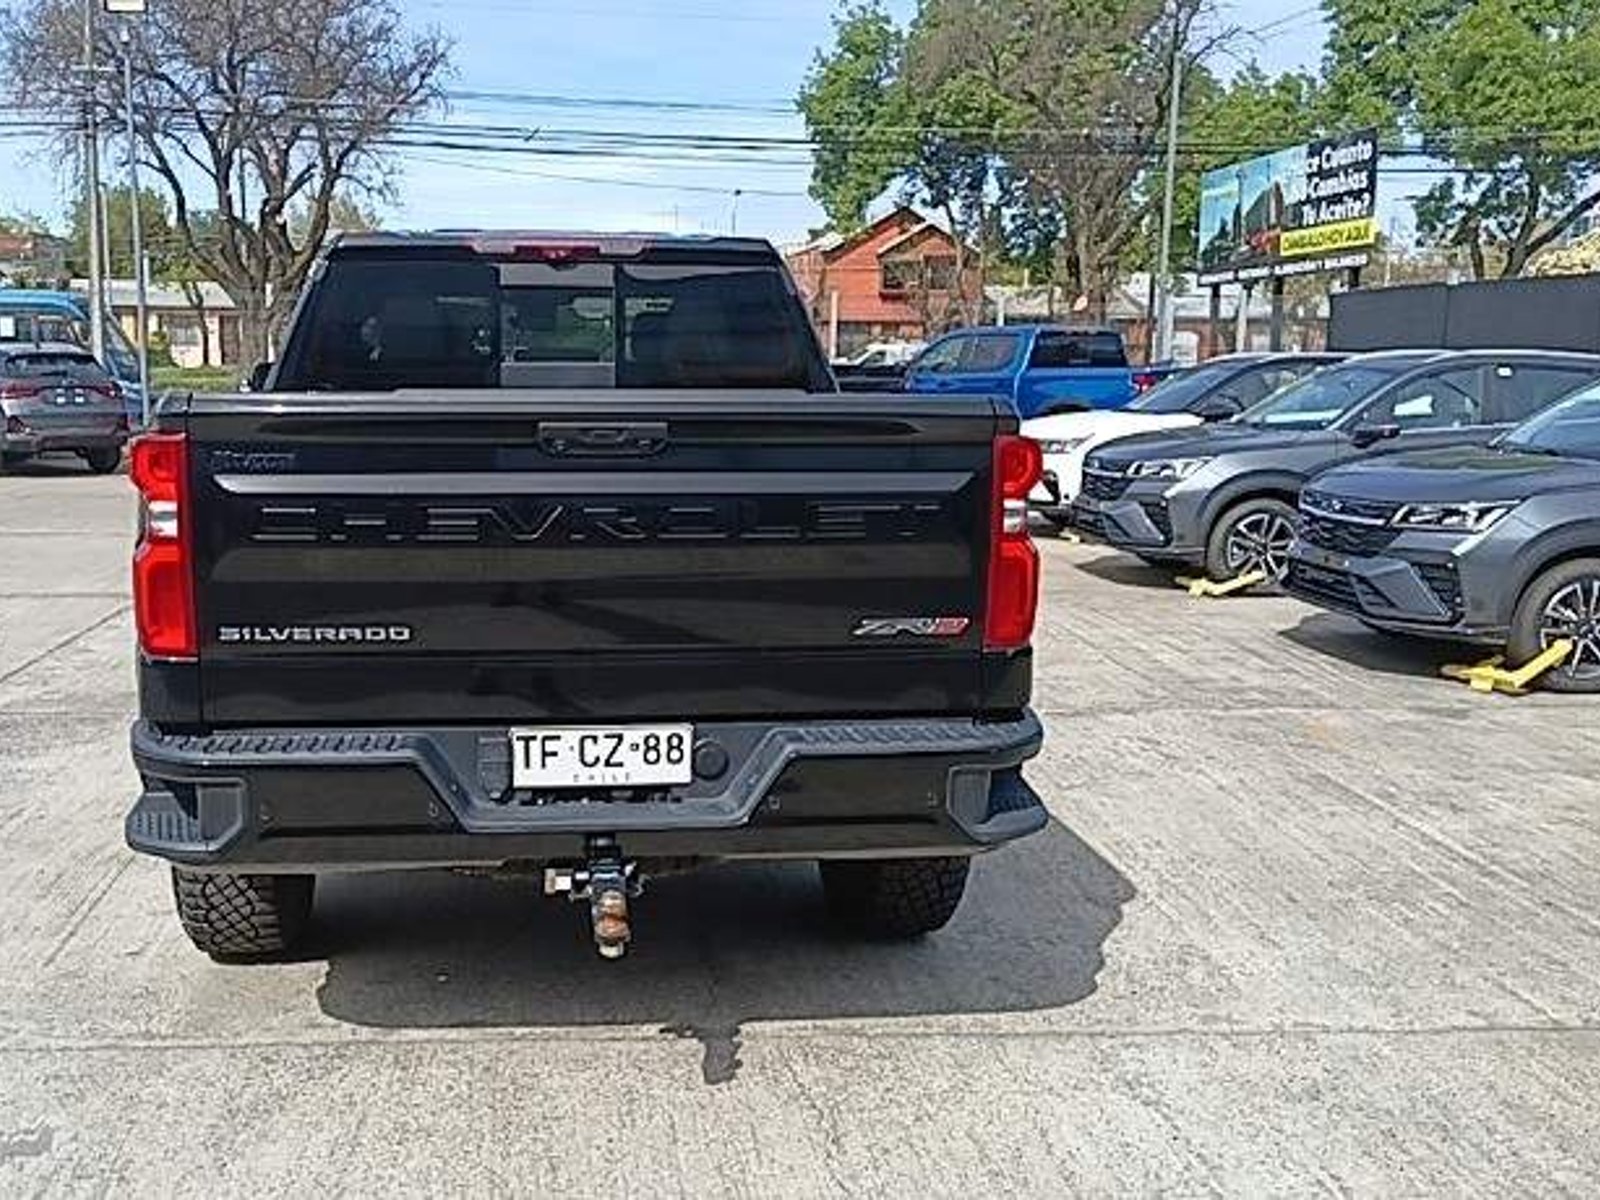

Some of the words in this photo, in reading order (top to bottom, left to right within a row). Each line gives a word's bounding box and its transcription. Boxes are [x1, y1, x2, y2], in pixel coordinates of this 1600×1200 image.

[1322, 140, 1373, 169] Cuanto
[1309, 168, 1368, 198] Cambias
[1317, 192, 1371, 222] Aceite?
[251, 502, 943, 542] CHEVROLET
[218, 626, 411, 642] SILVERADO
